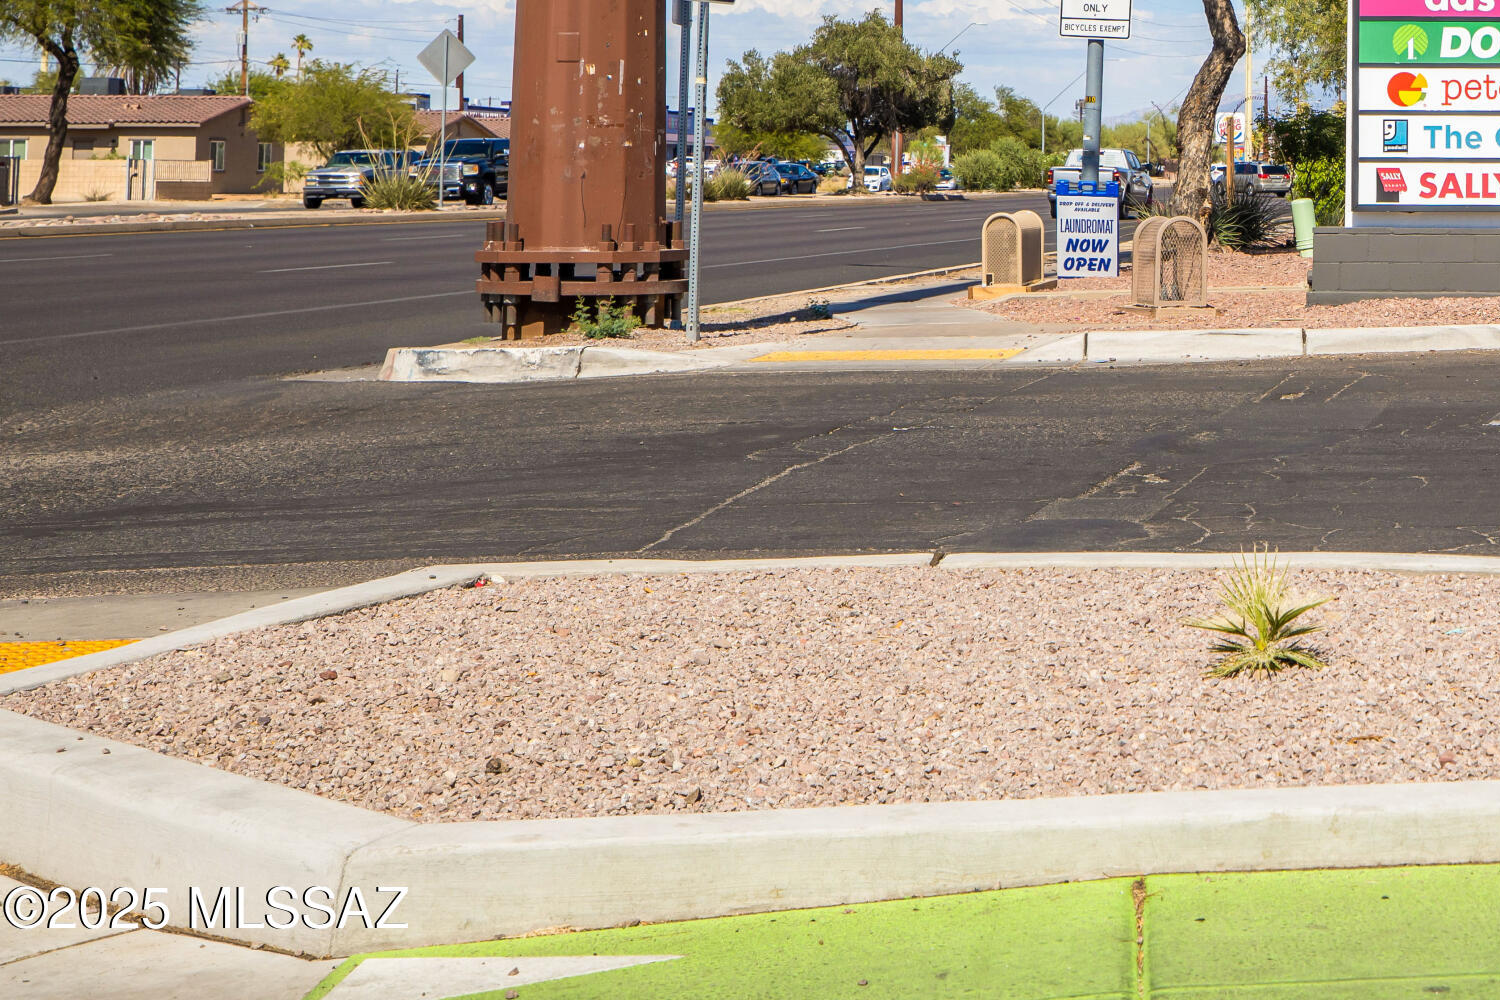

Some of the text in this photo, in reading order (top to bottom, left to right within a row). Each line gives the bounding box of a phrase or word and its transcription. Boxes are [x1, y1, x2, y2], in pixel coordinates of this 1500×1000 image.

[1083, 3, 1108, 13] ONLY
[1064, 23, 1125, 33] BICYCLES EXEMPT
[1423, 124, 1482, 150] The
[1380, 172, 1401, 180] SALLY
[1060, 218, 1114, 234] LAUNDROMAT
[1065, 238, 1110, 253] NOW
[1063, 256, 1112, 272] OPEN
